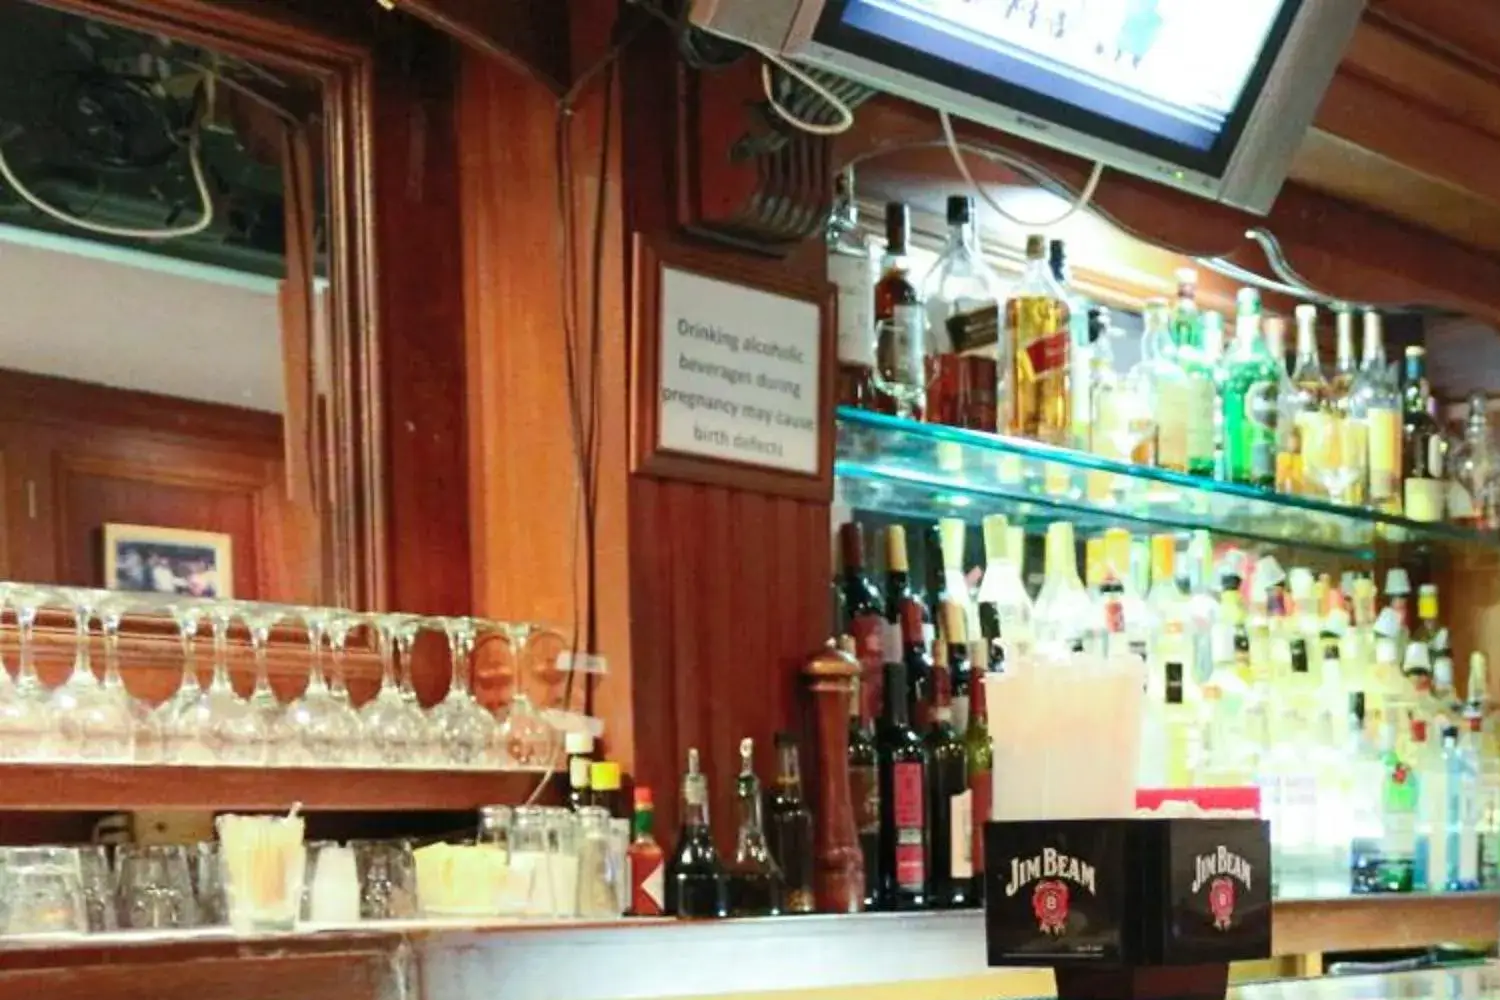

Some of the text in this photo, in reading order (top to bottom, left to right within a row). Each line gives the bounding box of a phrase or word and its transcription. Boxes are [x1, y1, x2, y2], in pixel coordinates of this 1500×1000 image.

[677, 317, 804, 365] Drinking alcoholic
[679, 352, 801, 399] beverages during
[662, 386, 814, 433] pregnancy may cause
[693, 421, 784, 457] birth defects
[1005, 847, 1097, 897] JIM BEAM
[1192, 845, 1252, 894] JIM BEAM
